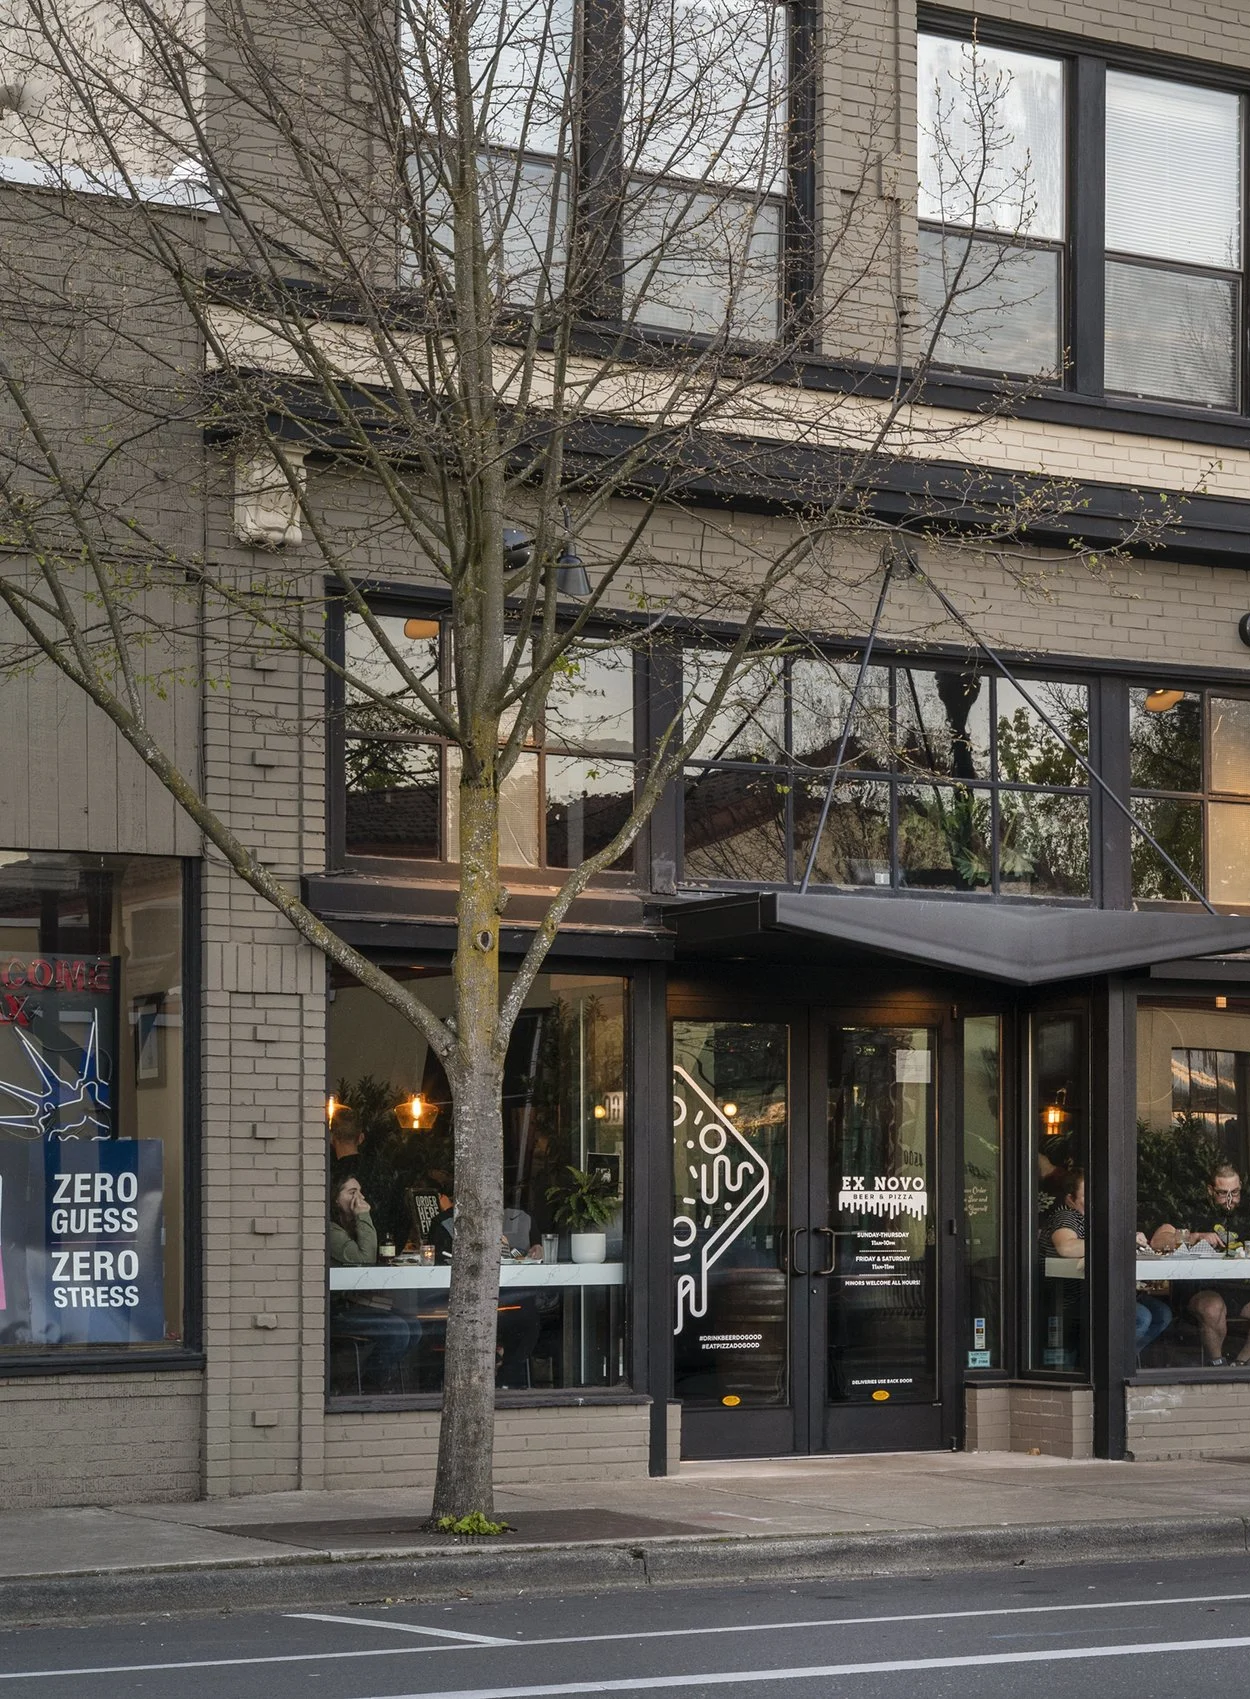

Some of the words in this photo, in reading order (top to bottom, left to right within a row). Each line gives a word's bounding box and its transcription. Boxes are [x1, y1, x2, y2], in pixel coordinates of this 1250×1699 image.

[52, 1172, 138, 1204] ZERO
[842, 1176, 865, 1191] EX
[874, 1176, 924, 1191] NOVO
[415, 1195, 438, 1207] ORDER
[51, 1207, 139, 1234] GUESS
[51, 1250, 139, 1282] ZERO
[53, 1286, 140, 1308] STRESS
